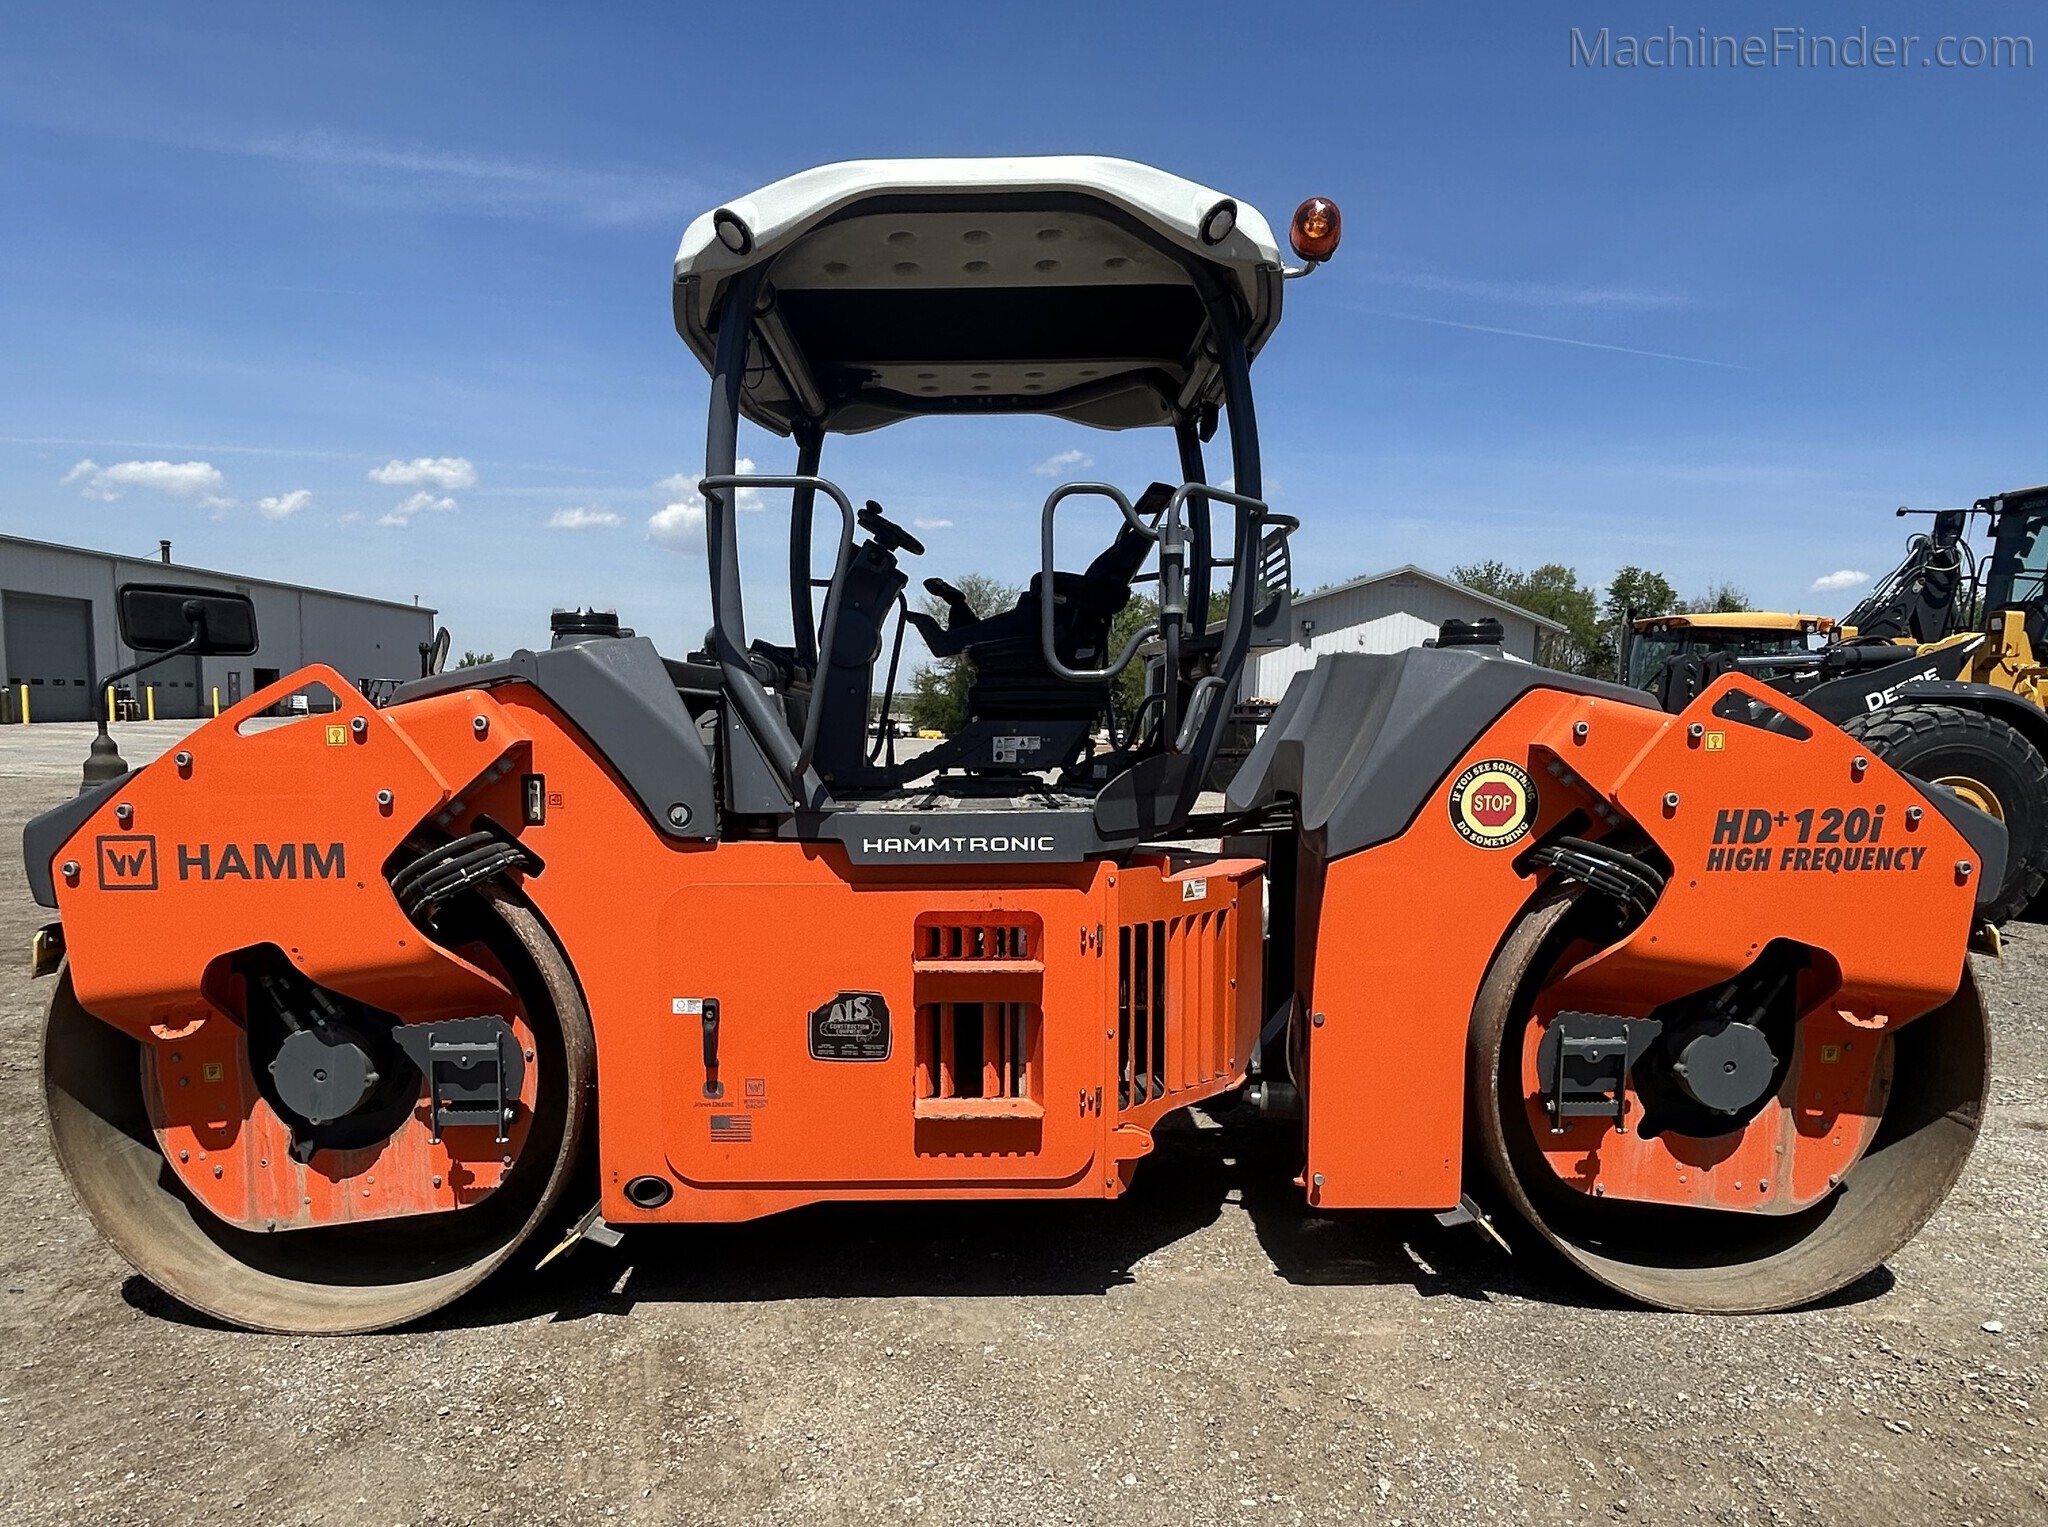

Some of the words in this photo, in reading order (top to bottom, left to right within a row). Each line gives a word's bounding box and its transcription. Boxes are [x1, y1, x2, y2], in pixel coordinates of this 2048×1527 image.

[1473, 763, 1491, 775] SEE
[1456, 771, 1473, 790] YOU
[1452, 791, 1462, 802] IF
[1474, 794, 1513, 812] STOP
[1457, 821, 1470, 836] DO
[1469, 821, 1529, 847] SOMETHING
[863, 837, 1055, 853] HAMMTRONIC
[177, 843, 346, 880] HAMM
[1706, 848, 1772, 872] HIGH
[1780, 847, 1928, 874] FREQUENCY
[828, 996, 873, 1022] AIS
